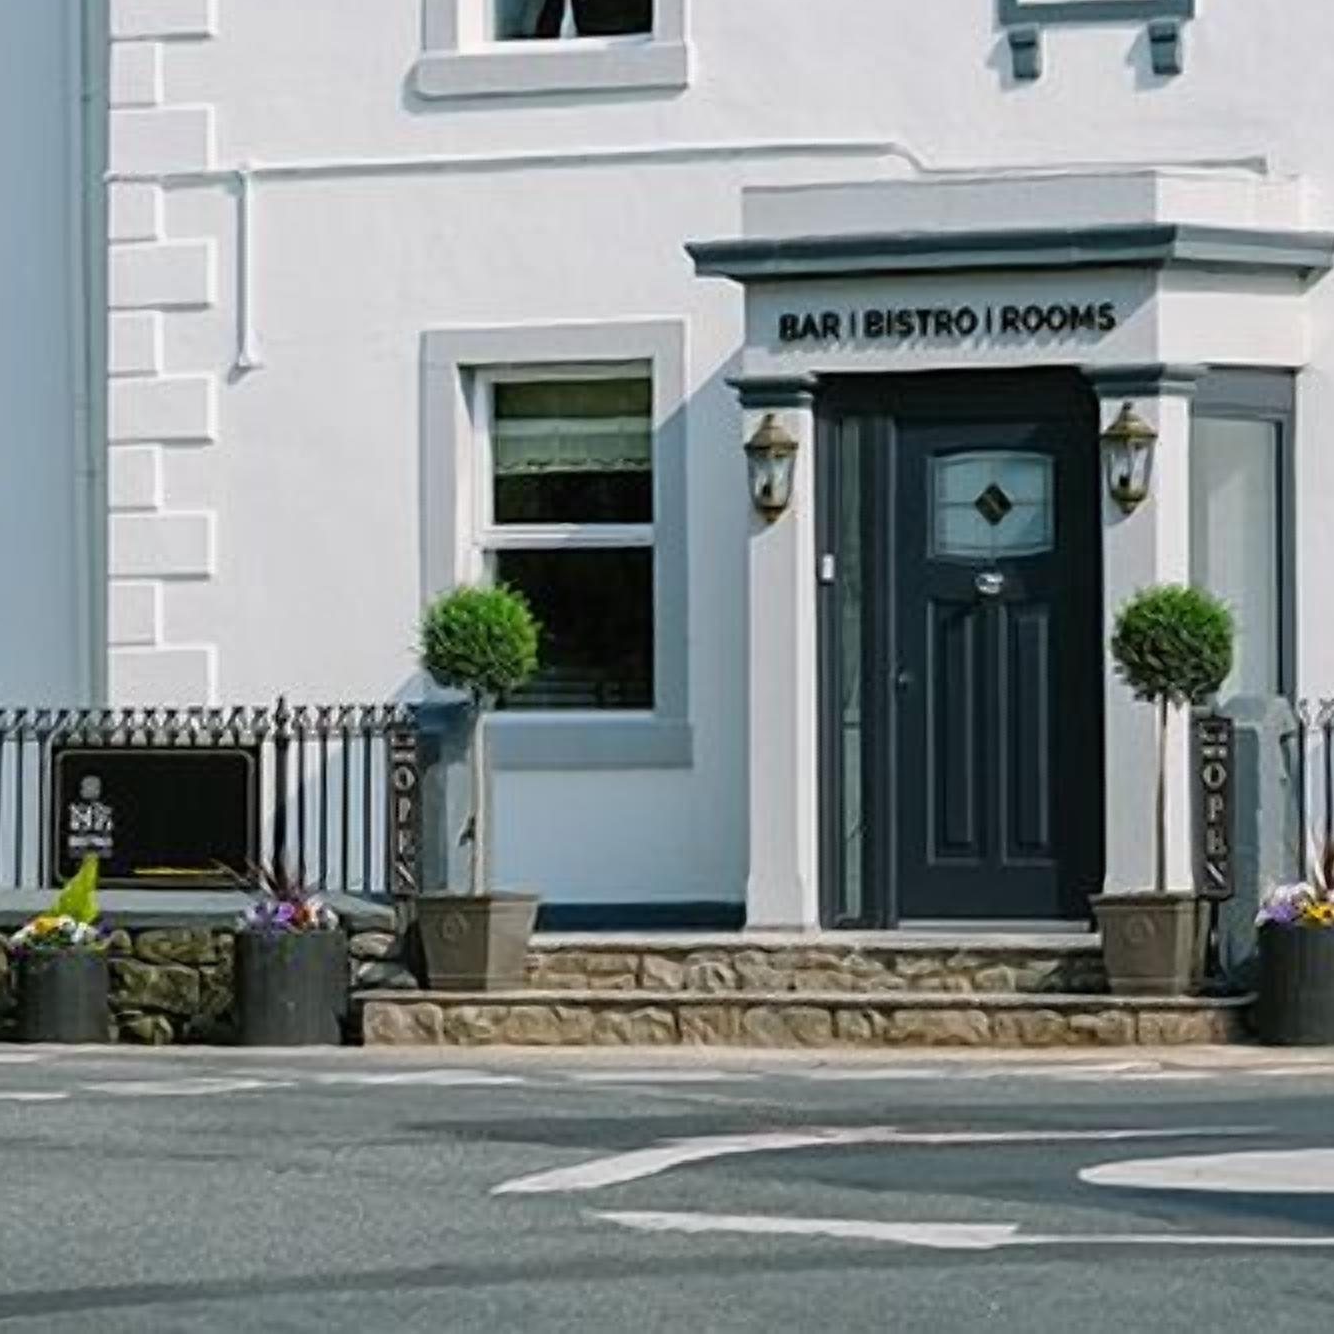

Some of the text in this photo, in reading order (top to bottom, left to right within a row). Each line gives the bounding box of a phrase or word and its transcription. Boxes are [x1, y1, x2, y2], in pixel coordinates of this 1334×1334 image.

[778, 302, 1117, 341] BAR BISTRO ROOMS
